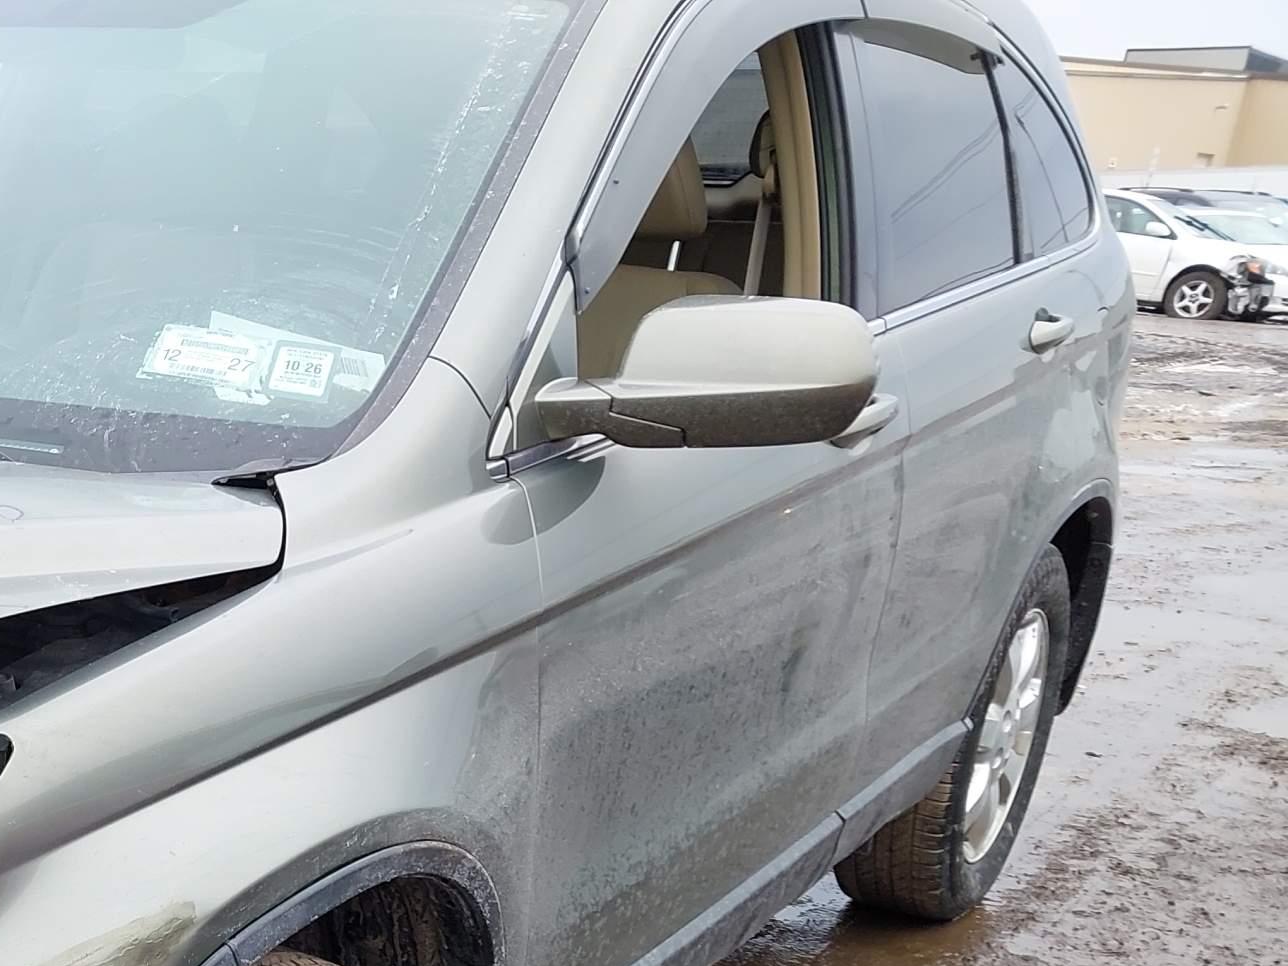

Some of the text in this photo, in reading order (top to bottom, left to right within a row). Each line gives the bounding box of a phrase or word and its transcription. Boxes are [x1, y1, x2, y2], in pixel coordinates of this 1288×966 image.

[162, 348, 183, 362] 12
[227, 358, 257, 372] 27
[284, 359, 301, 371] 10
[304, 362, 323, 375] 26
